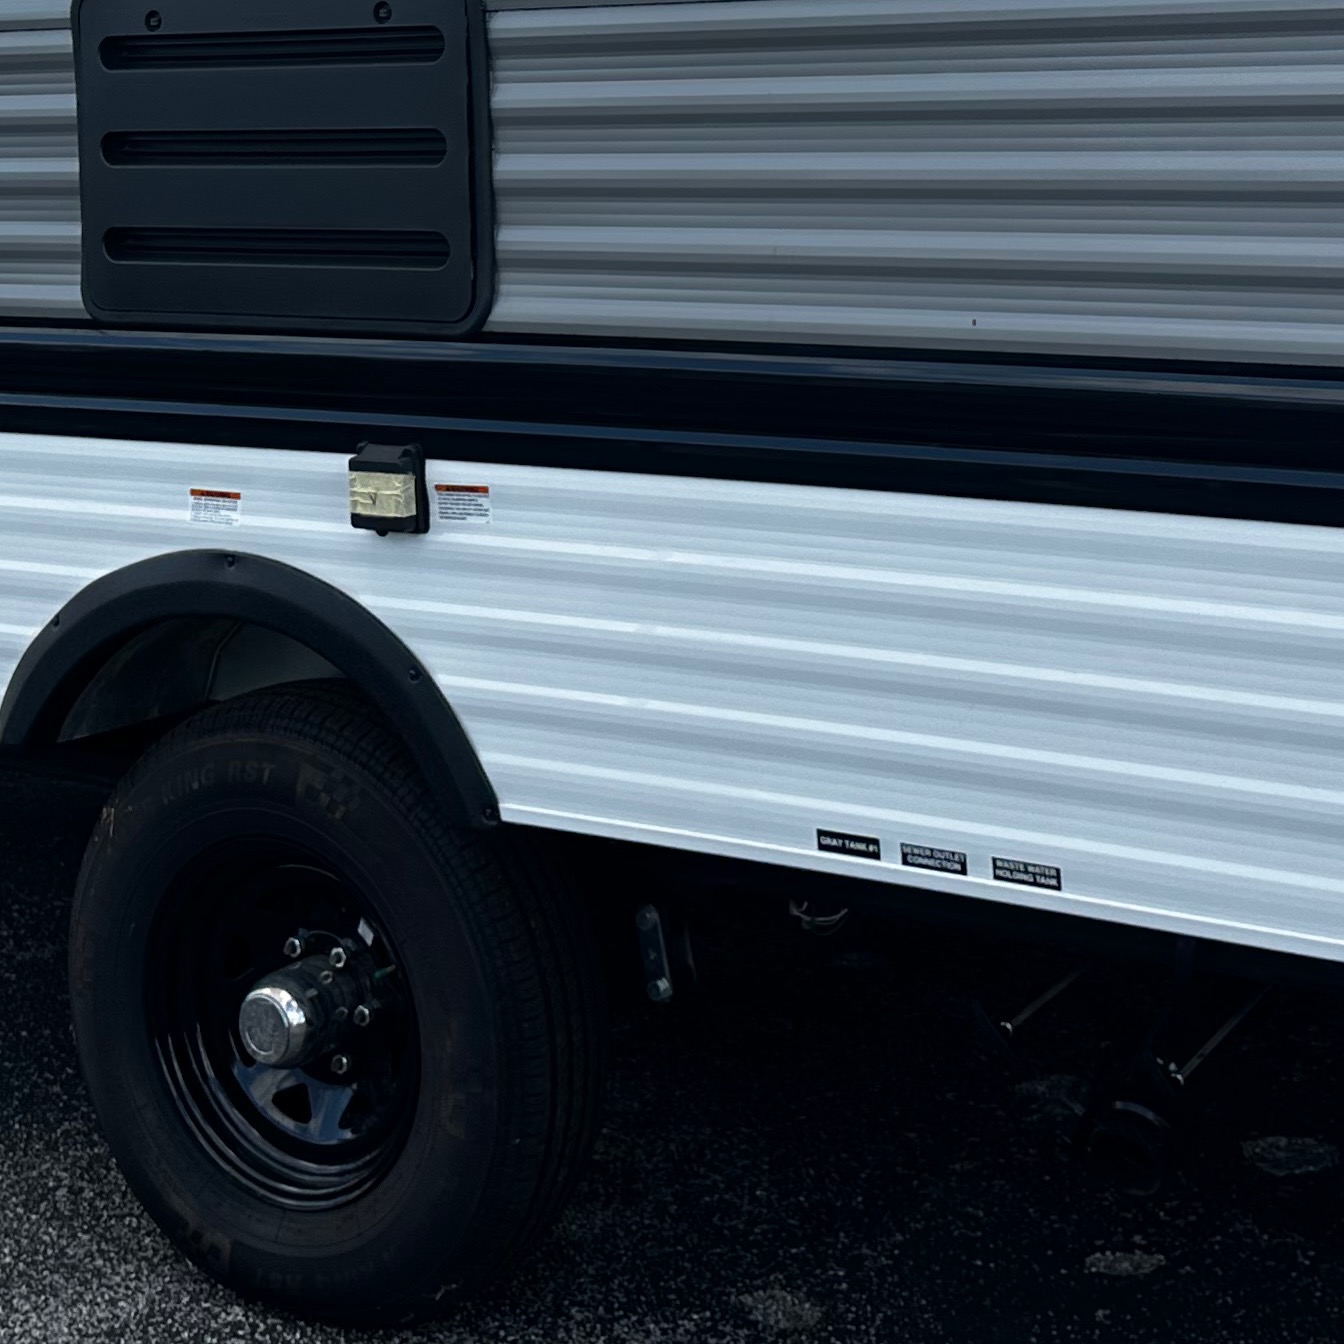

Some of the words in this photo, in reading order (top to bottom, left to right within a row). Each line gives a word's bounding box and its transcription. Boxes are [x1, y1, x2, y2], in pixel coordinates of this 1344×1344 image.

[819, 835, 843, 848] GRAY
[844, 838, 868, 851] TANK
[907, 854, 962, 871] CONNECTION
[996, 859, 1026, 872] WASTE
[1026, 864, 1057, 876] WATER
[995, 868, 1034, 882] HOLDING
[1035, 875, 1059, 887] TANK
